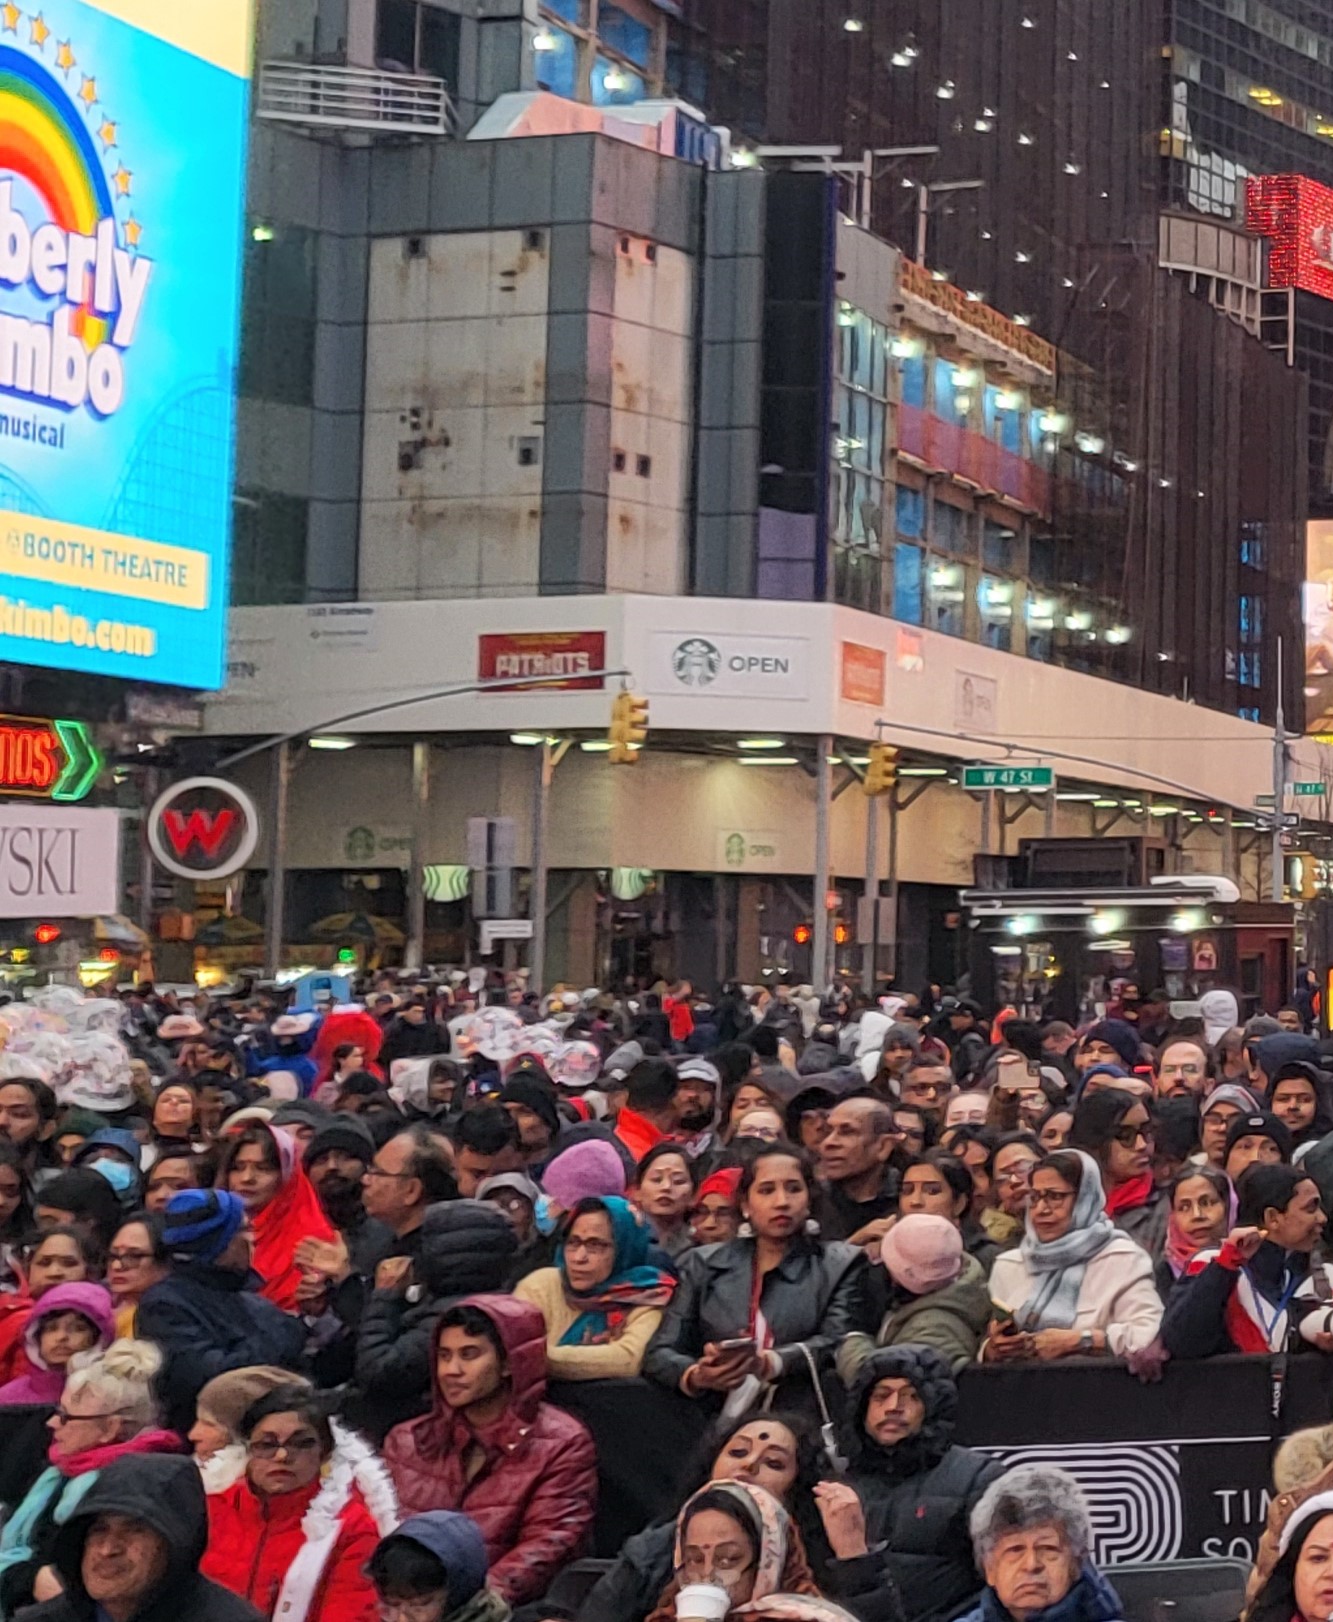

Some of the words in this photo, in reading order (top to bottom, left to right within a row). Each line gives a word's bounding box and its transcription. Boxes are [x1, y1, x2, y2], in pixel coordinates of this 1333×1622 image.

[23, 532, 95, 570] BOOTH
[101, 548, 188, 588] THEATRE
[728, 655, 789, 674] OPEN
[983, 771, 996, 784] W
[1000, 771, 1016, 784] 47
[162, 808, 236, 859] W
[0, 826, 80, 896] SKI
